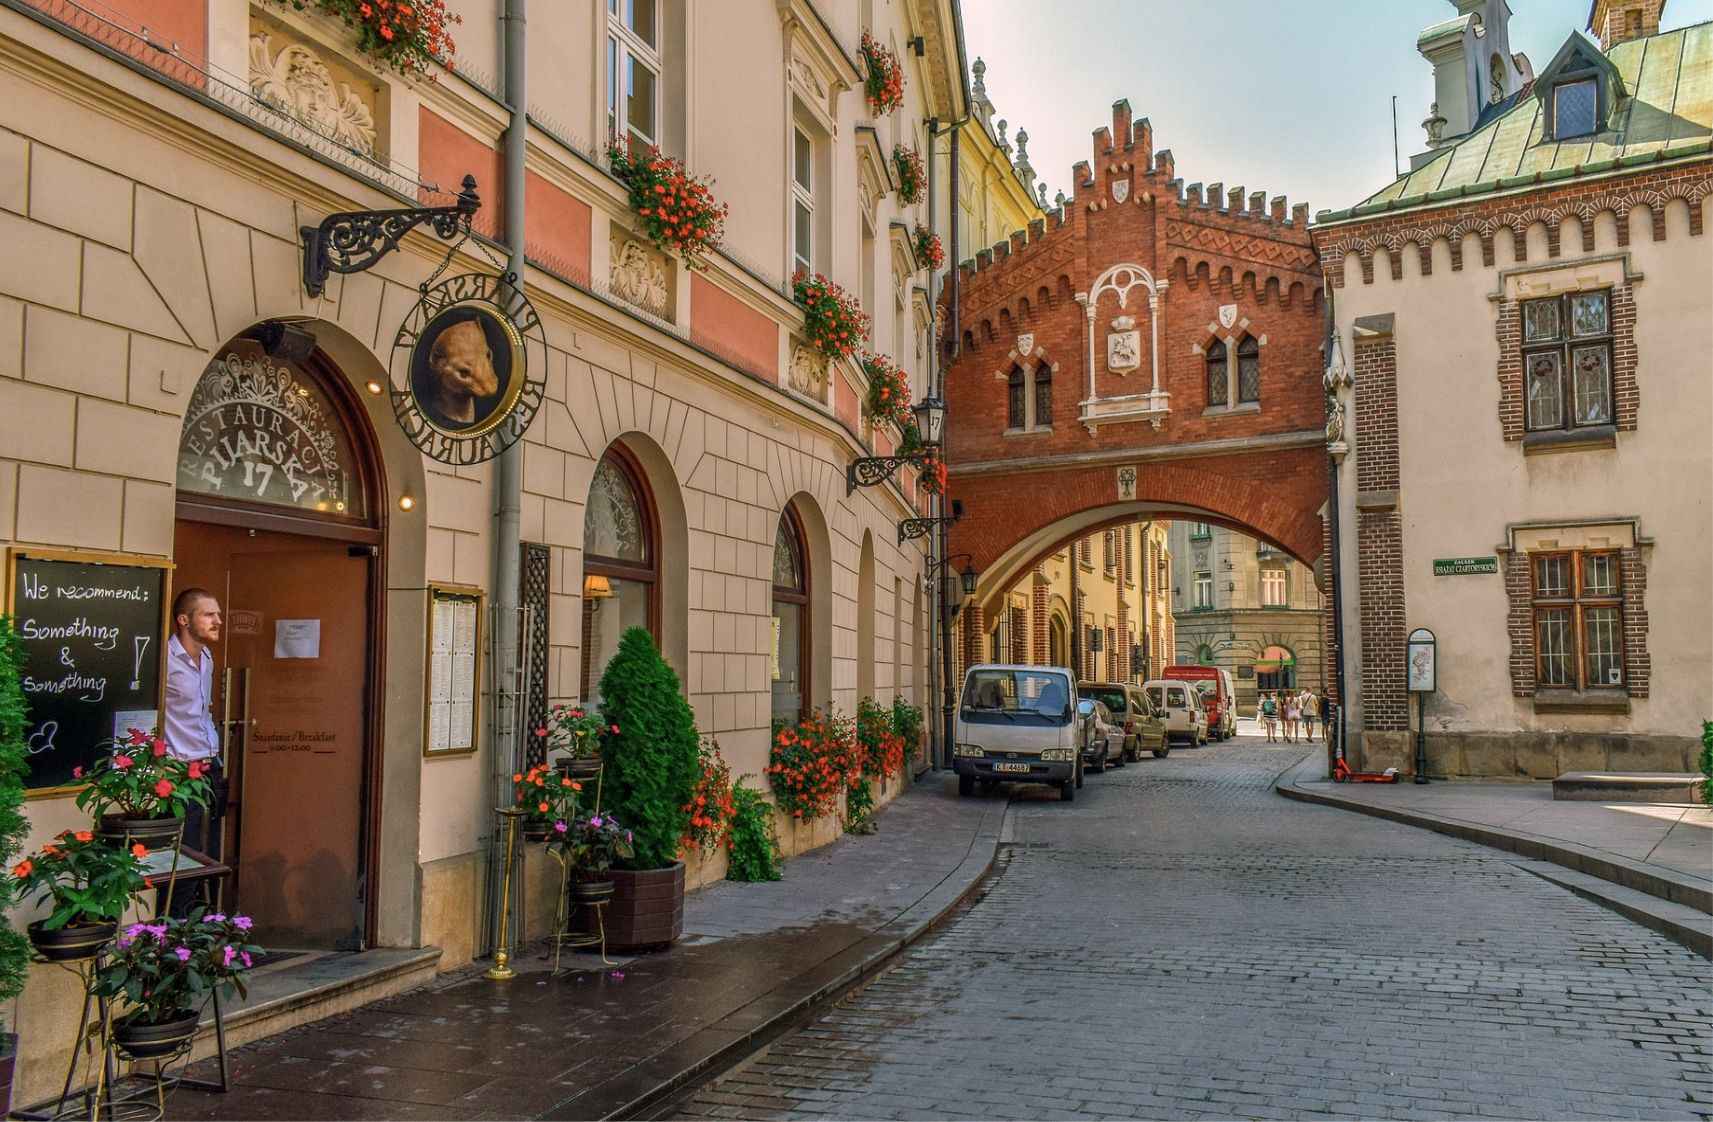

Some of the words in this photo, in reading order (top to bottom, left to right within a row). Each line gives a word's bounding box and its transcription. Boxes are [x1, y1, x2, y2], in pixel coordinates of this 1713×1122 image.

[201, 429, 309, 502] PIJARSKA
[243, 461, 274, 497] 17
[23, 573, 49, 600] We
[57, 585, 150, 602] recommend:
[23, 617, 120, 651] Something
[60, 646, 76, 668] &
[23, 671, 107, 703] Something
